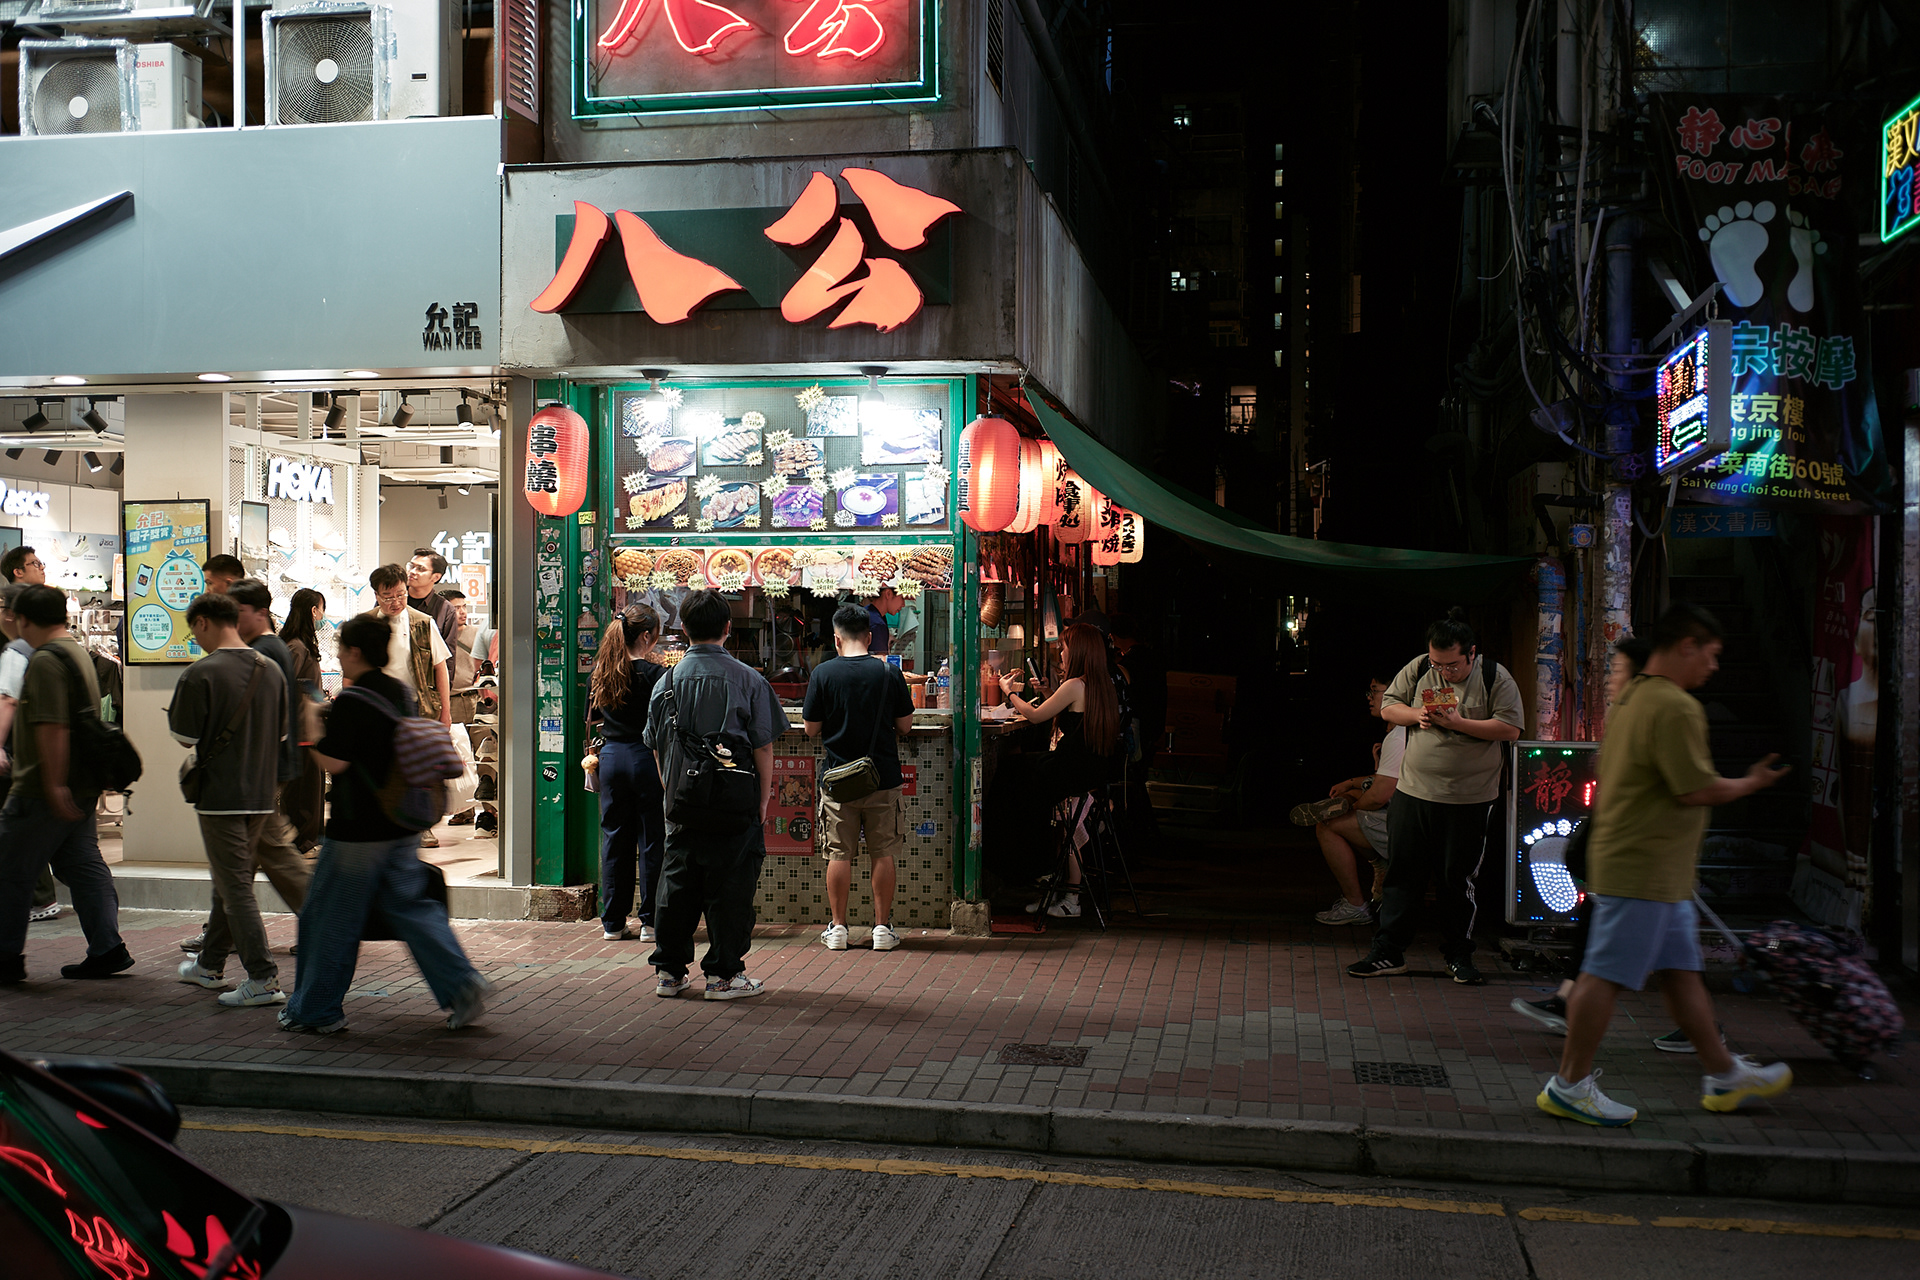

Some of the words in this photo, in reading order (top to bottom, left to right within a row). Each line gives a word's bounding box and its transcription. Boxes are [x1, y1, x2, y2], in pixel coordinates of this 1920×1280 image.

[135, 60, 165, 68] OSHIBA
[1675, 154, 1744, 185] FOOT
[530, 166, 965, 334] 八公
[424, 301, 480, 332] 允記
[422, 331, 452, 351] WAN
[456, 330, 482, 350] KEE
[1731, 319, 1858, 391] 宗按摩
[1749, 424, 1784, 441] jing
[1787, 429, 1806, 444] lou
[268, 457, 334, 505] HOKA
[1681, 476, 1700, 488] Sai
[1703, 478, 1738, 495] Yeung
[1741, 482, 1769, 496] Choi
[1771, 486, 1812, 500] South
[1814, 488, 1852, 502] Street
[136, 511, 164, 530] 允記
[1675, 511, 1772, 533] 漢文書局
[431, 530, 491, 565] 允記
